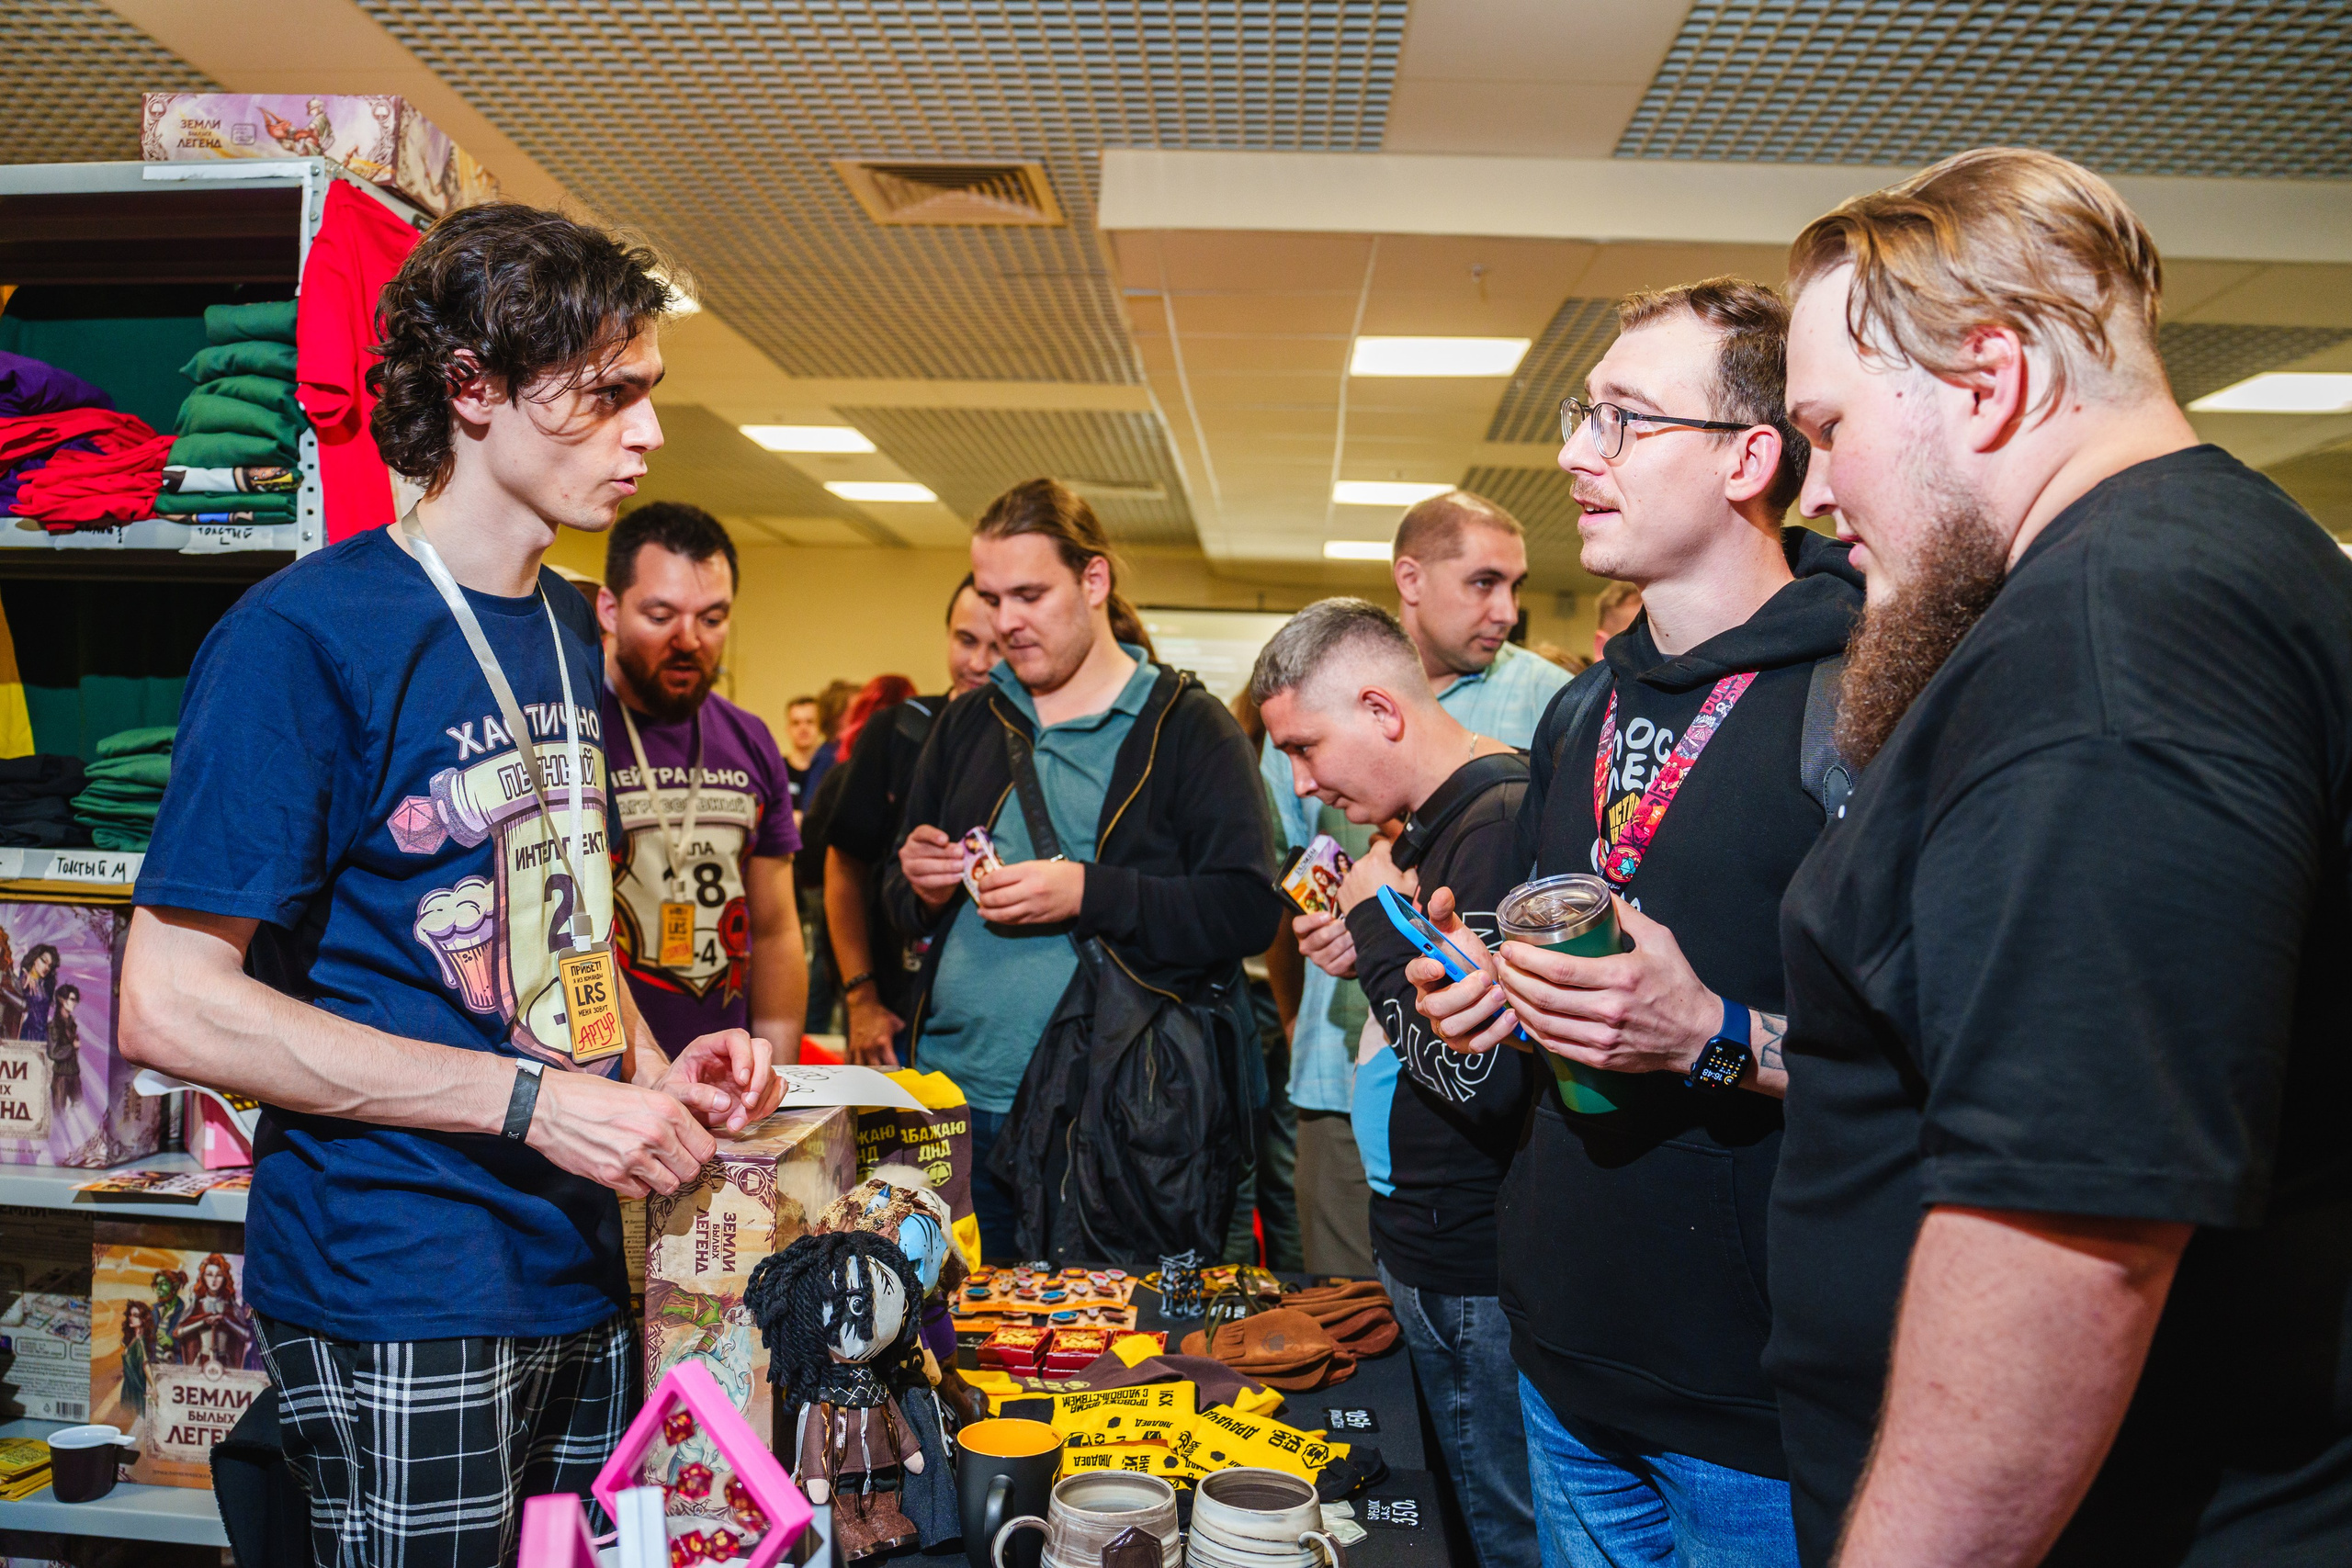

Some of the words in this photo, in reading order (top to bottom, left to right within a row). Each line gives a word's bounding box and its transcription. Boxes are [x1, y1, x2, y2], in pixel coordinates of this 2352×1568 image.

[180, 119, 220, 129] ЗЕМЛИ
[176, 139, 222, 147] ЛЕГЕНД
[497, 748, 596, 801] ПЬНЙ
[571, 961, 603, 977] ПРИВЕТ!
[584, 973, 604, 982] КОМАНДЫ
[575, 981, 606, 1007] LRS
[578, 1008, 592, 1018] МЕНЯ
[594, 1005, 608, 1014] ЗОВУТ
[579, 1012, 616, 1051] АРТУР
[1702, 1068, 1723, 1081] 16:48
[917, 1138, 952, 1163] ДНД
[695, 1205, 709, 1275] ЛЕГЕНД
[712, 1224, 720, 1259] БЫЛЫХ
[722, 1213, 737, 1273] ЗЕМЛИ
[172, 1385, 253, 1409] ЗЕМЛИ
[1062, 1389, 1141, 1407] УДОВОЛЬСТВИЕМ
[1143, 1388, 1148, 1398] С
[187, 1411, 235, 1424] БЫЛЫХ
[1135, 1418, 1174, 1428] ЛЮДОЕД
[164, 1426, 230, 1446] ЛЕГЕ
[1073, 1453, 1112, 1467] ЛЮДОЕД
[1381, 1506, 1391, 1519] LRS
